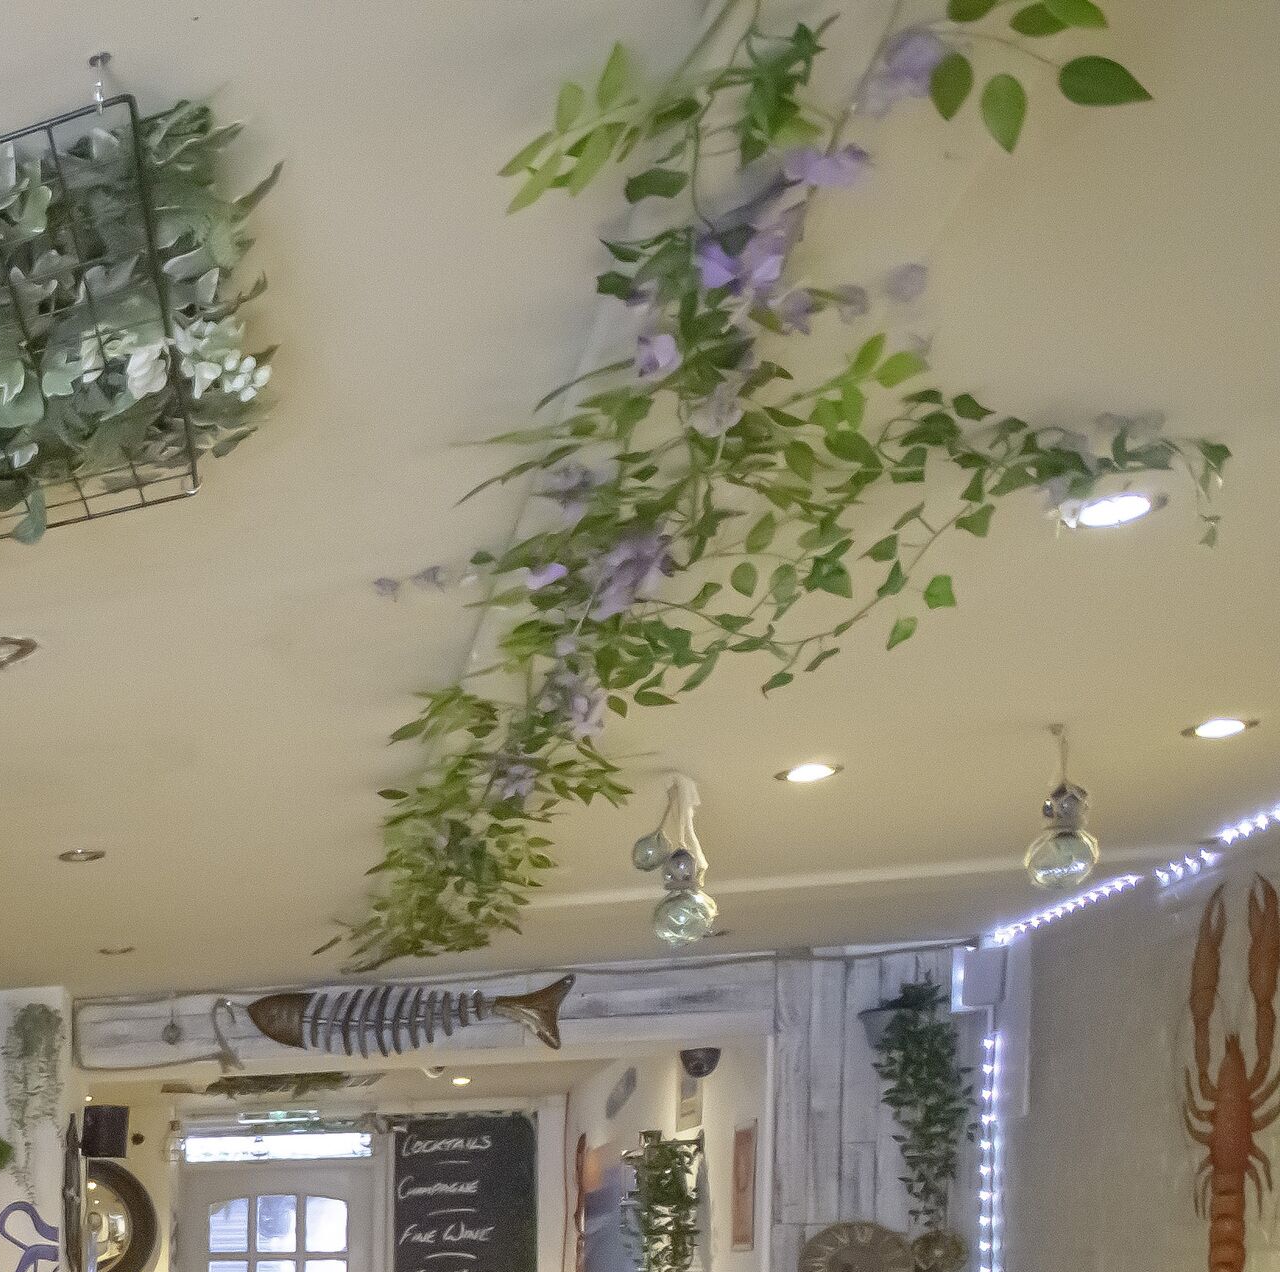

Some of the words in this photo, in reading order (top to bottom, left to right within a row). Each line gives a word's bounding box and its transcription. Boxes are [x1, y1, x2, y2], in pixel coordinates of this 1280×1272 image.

[402, 1134, 492, 1157] COCKTAILS
[399, 1223, 437, 1245] FINE
[442, 1221, 495, 1242] WINE
